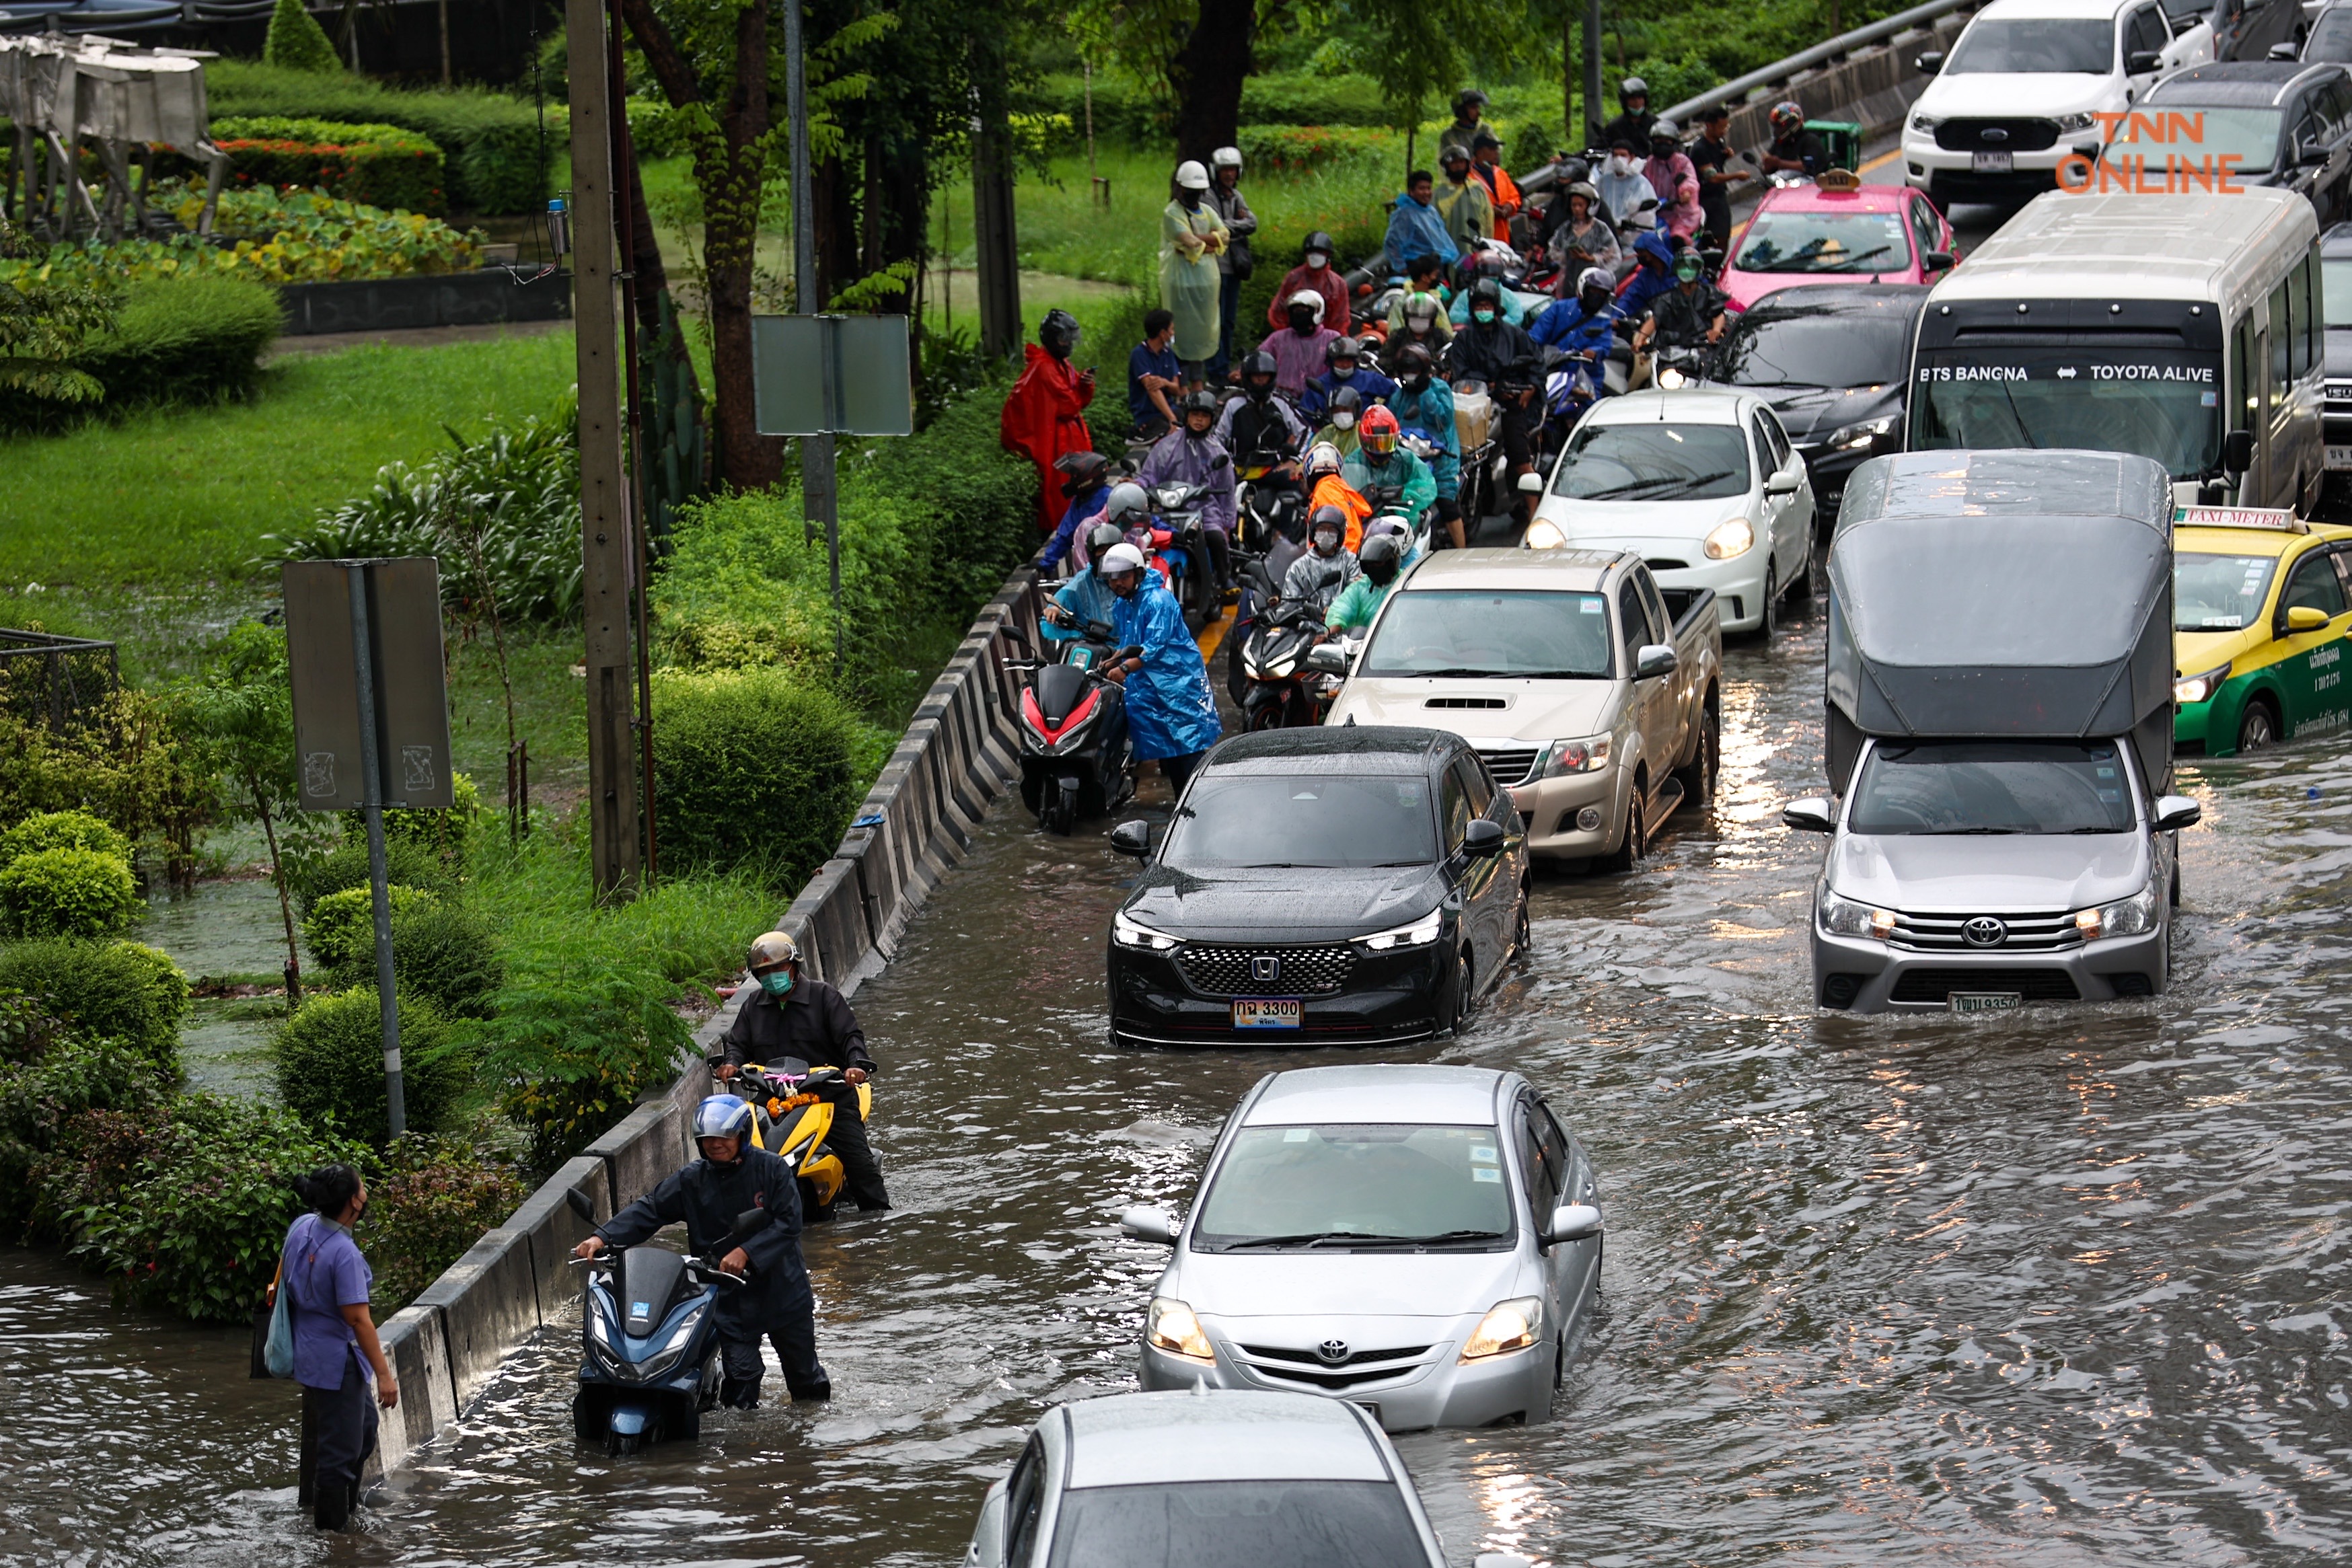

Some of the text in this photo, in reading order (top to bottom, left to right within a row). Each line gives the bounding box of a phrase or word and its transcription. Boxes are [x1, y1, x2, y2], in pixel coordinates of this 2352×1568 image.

[1920, 365, 2213, 382] BTS BANGNA TOYOTA ALIVE
[2188, 510, 2282, 525] TAXI-METER
[1237, 1002, 1298, 1015] กฉ 3300
